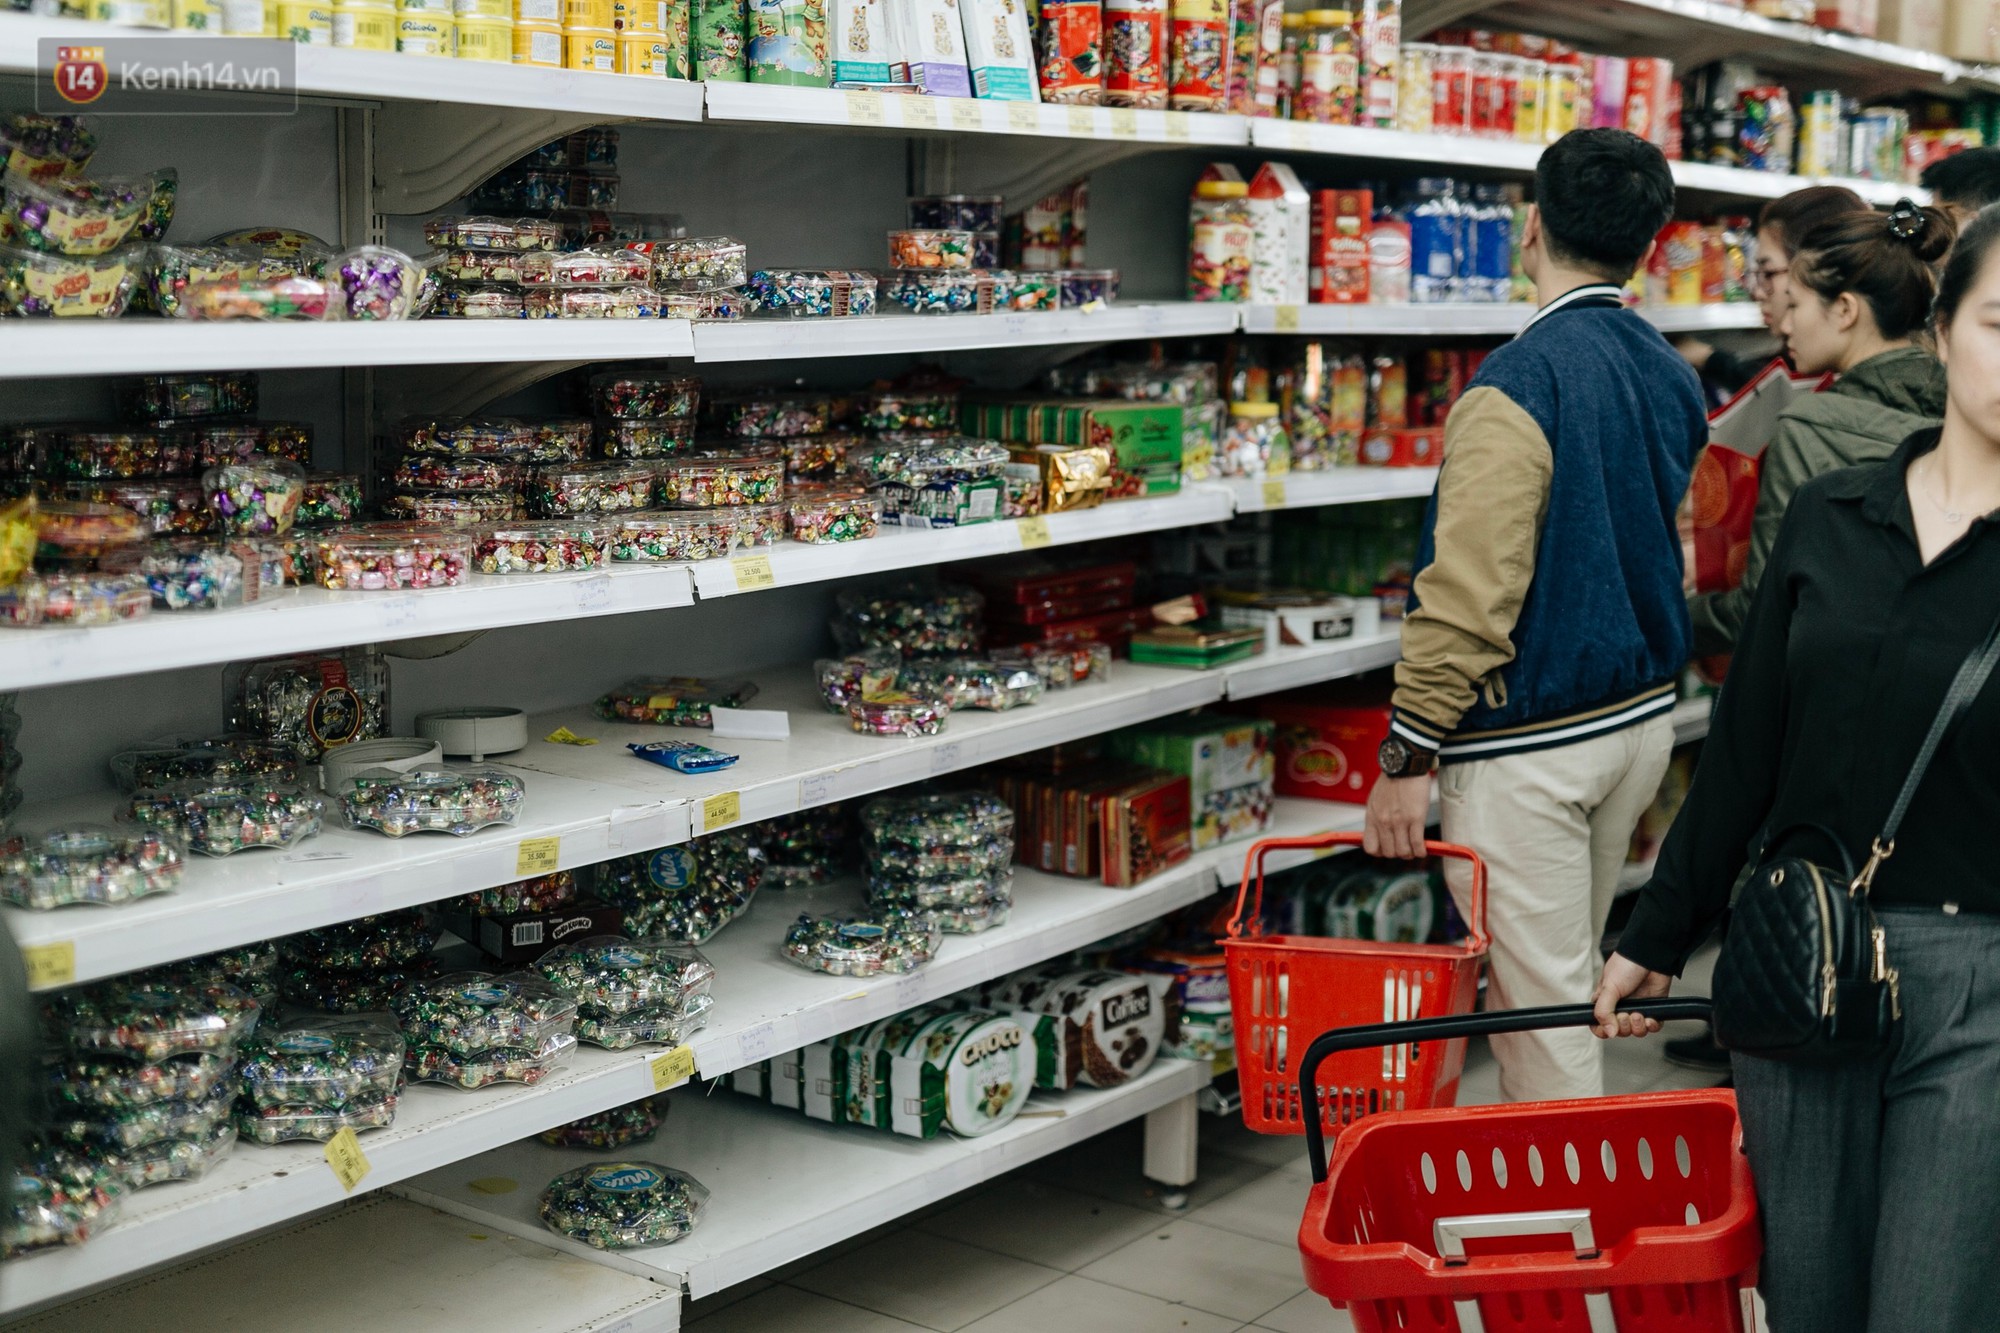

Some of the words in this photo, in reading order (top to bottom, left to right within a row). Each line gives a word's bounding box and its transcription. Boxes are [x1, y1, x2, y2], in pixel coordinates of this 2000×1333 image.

[401, 21, 437, 32] Ricola
[528, 852, 546, 861] 35.500
[961, 1027, 1023, 1067] CHOCO
[602, 1170, 651, 1188] Milk
